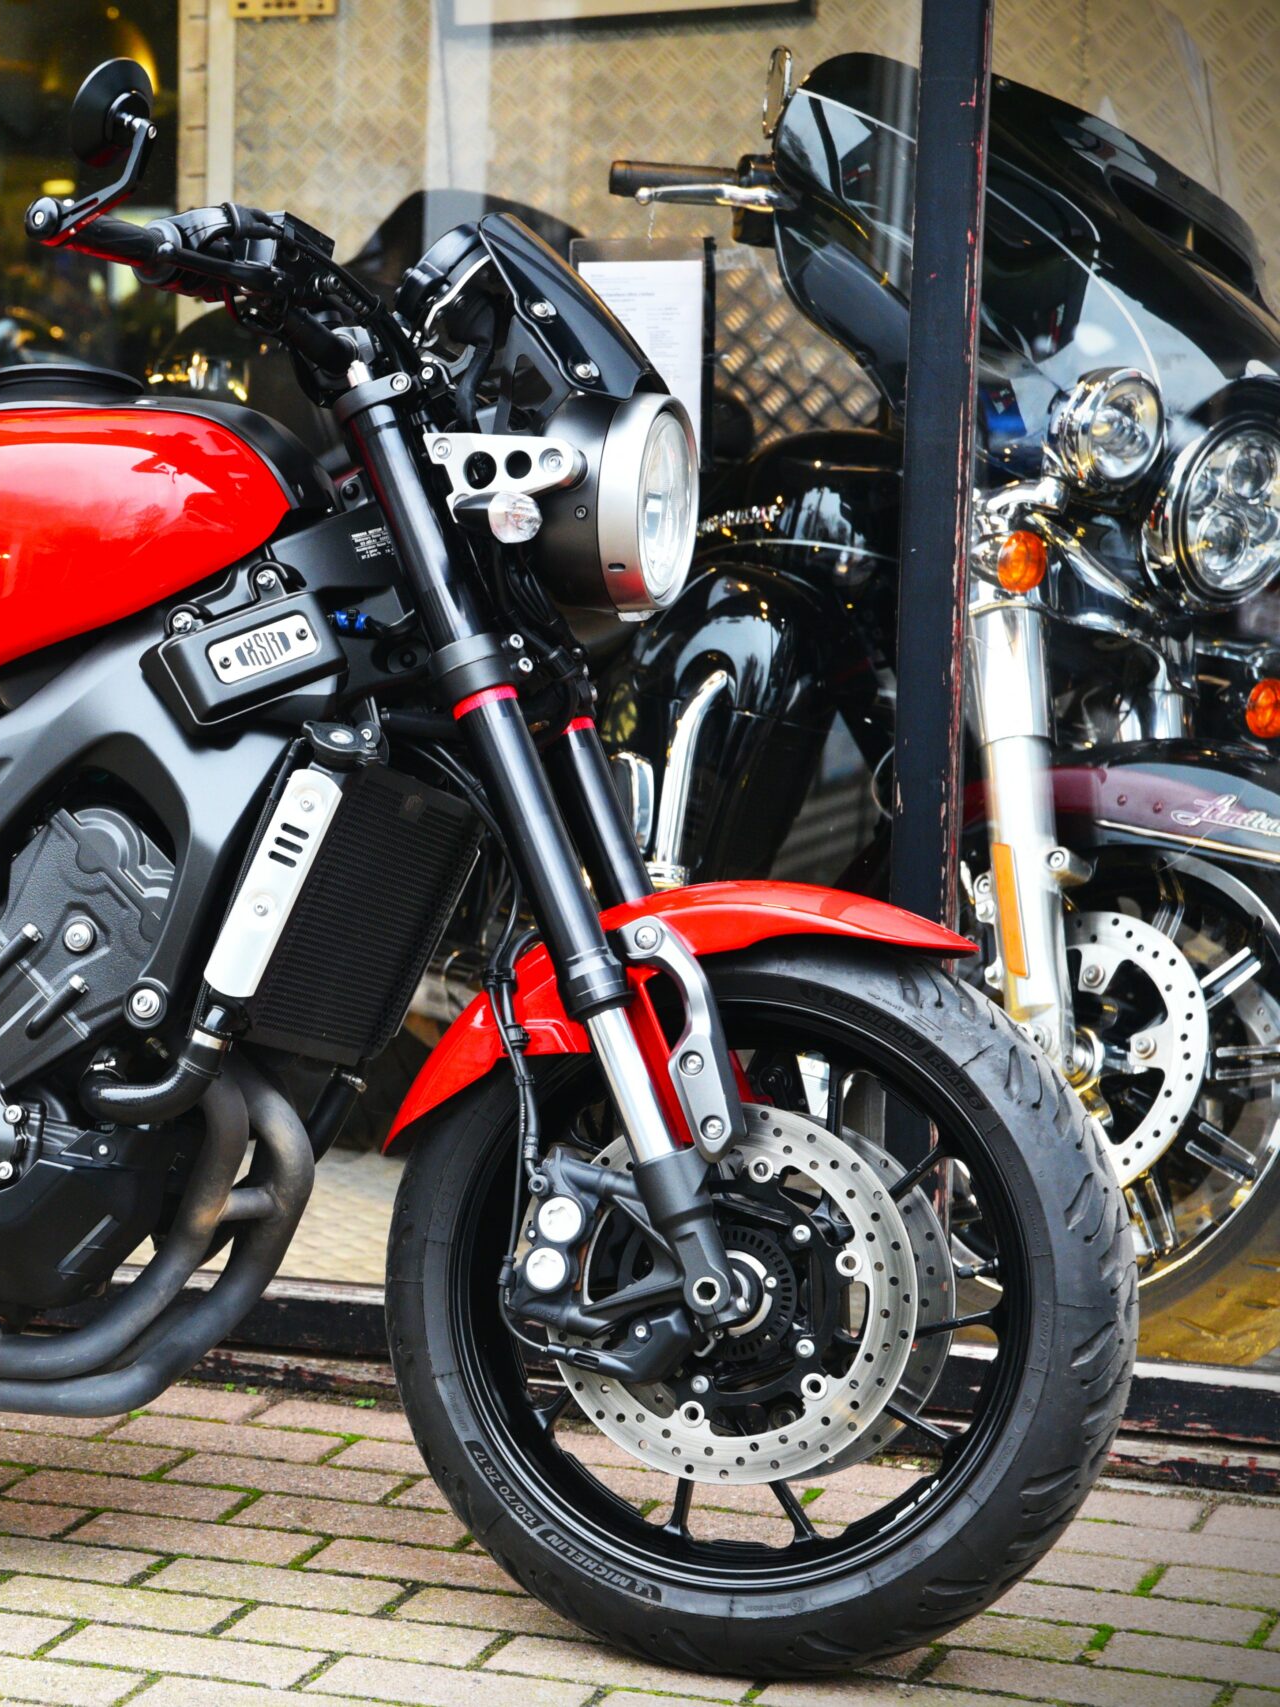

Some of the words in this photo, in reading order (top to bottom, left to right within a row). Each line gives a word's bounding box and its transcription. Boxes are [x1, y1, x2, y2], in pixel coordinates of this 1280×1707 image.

[243, 632, 283, 666] XSR
[829, 995, 919, 1048] MICHELIN
[474, 1450, 488, 1465] 17
[484, 1466, 502, 1484] ZR
[499, 1485, 537, 1526] 120/70
[545, 1534, 633, 1588] MICHELIN
